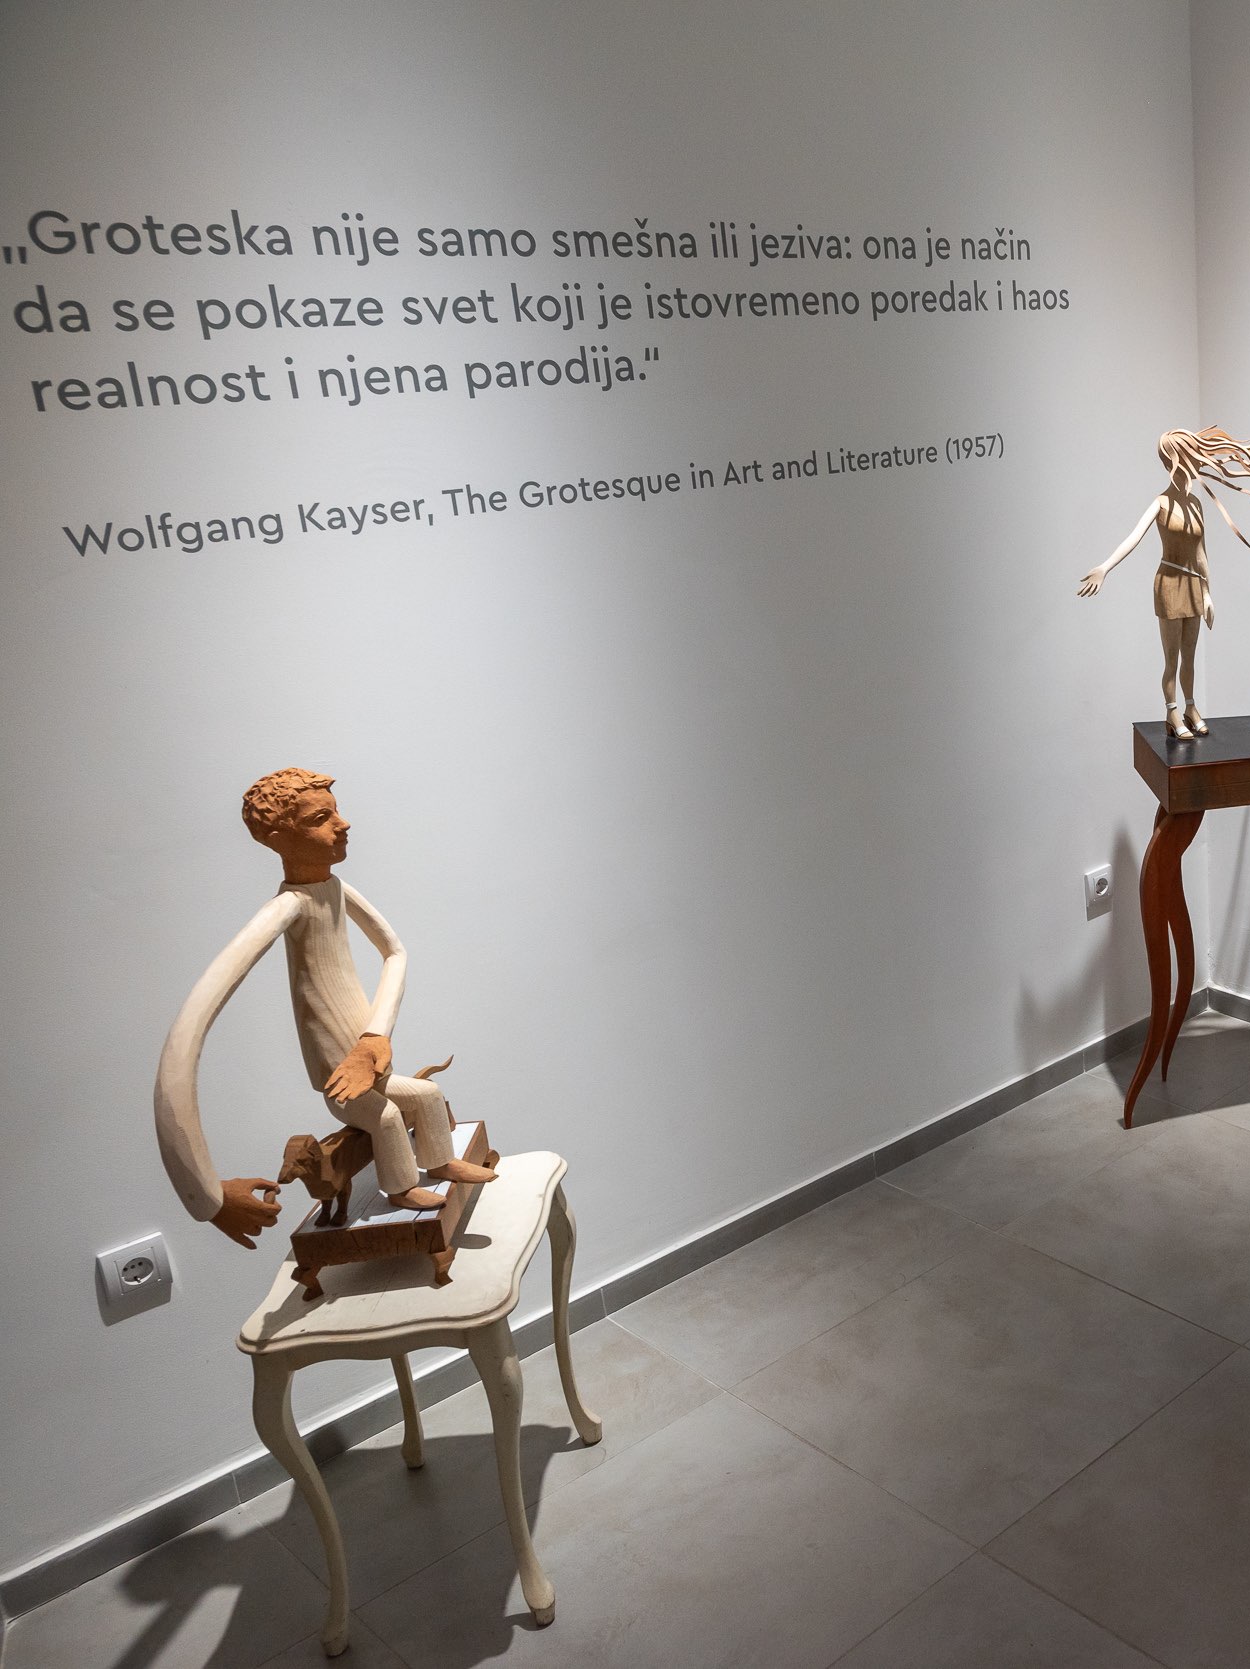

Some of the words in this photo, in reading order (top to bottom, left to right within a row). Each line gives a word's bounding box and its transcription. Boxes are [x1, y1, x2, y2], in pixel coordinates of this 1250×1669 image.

[311, 212, 400, 267] nije
[417, 227, 537, 258] samo
[551, 217, 698, 259] smešna
[709, 221, 739, 259] ili
[749, 222, 852, 268] jeziva:
[862, 236, 917, 260] ona
[924, 227, 951, 268] je
[960, 227, 1031, 261] način
[13, 284, 92, 334] da
[112, 299, 176, 332] se
[195, 283, 384, 341] pokaze
[401, 289, 499, 326] svet
[510, 282, 585, 331] koji
[597, 282, 632, 330] je
[644, 281, 860, 320] istovremeno
[870, 279, 989, 322] poredak
[997, 280, 1003, 311] i
[1011, 279, 1070, 311] haos
[30, 361, 272, 413] realnost
[284, 356, 300, 400] i
[317, 354, 449, 407] njena
[61, 511, 284, 558] Wolfgang
[297, 498, 434, 536] Kayser,
[441, 483, 508, 517] The
[518, 472, 681, 509] Grotesque
[690, 463, 715, 490] in
[723, 460, 764, 487] Art
[772, 449, 819, 481] and
[826, 445, 938, 475] Literature
[945, 432, 1004, 465] (1957)
